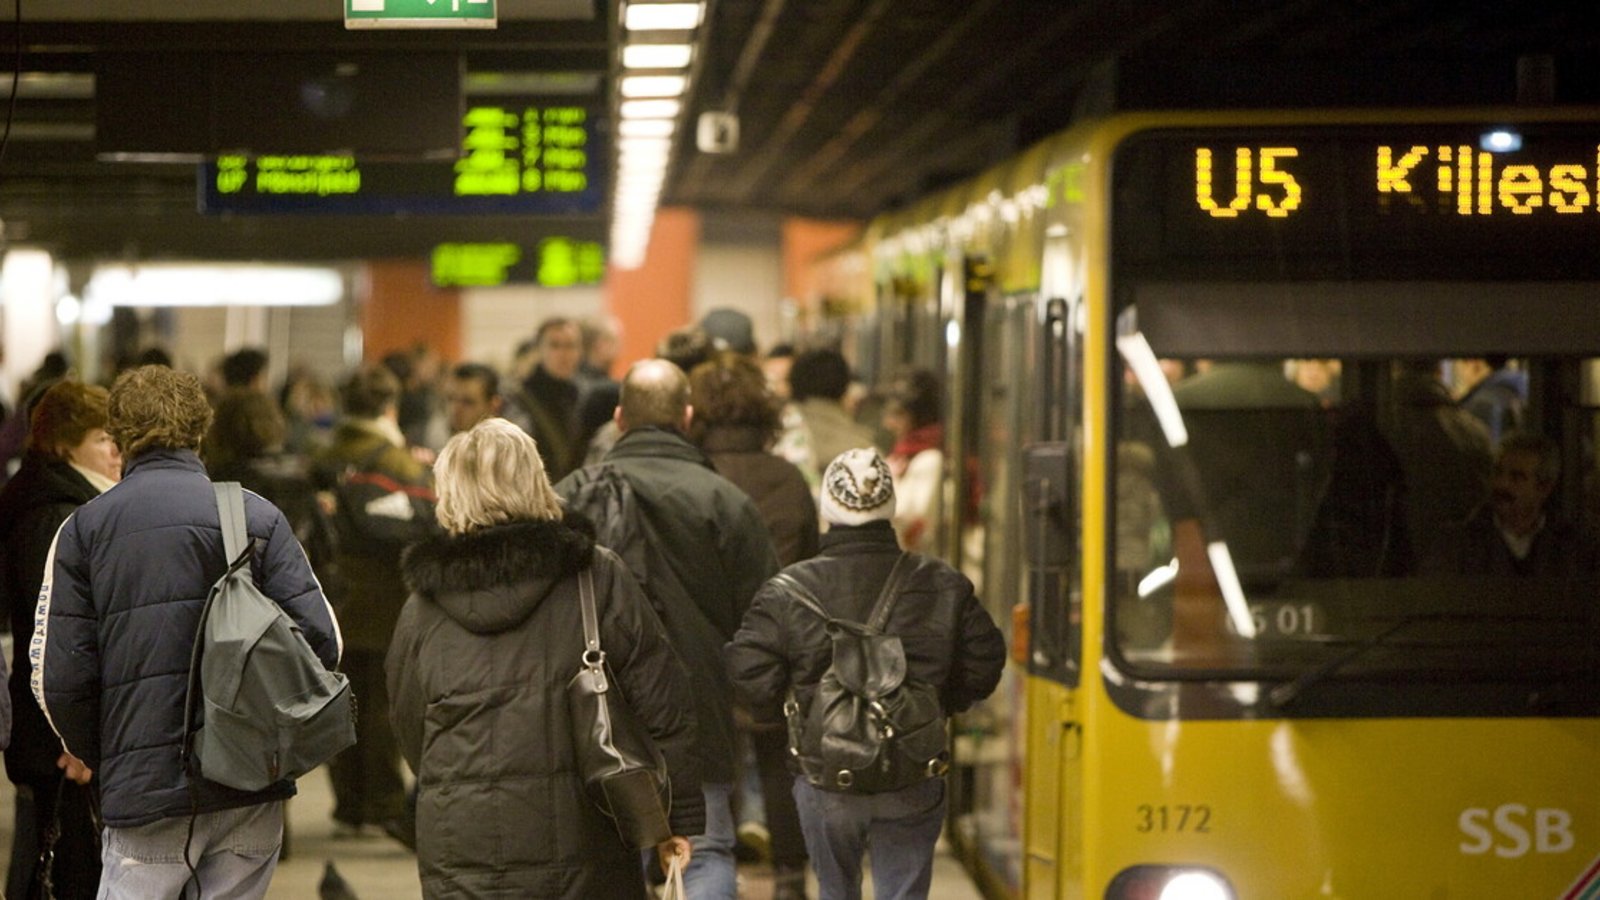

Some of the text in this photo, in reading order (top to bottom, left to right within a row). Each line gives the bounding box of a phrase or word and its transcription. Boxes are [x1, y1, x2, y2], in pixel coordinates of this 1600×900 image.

[1195, 145, 1600, 218] U5 Killes
[30, 585, 49, 671] DOWNTOWN
[1277, 604, 1313, 635] 01
[1136, 803, 1212, 834] 3172
[1458, 802, 1575, 858] SSB
